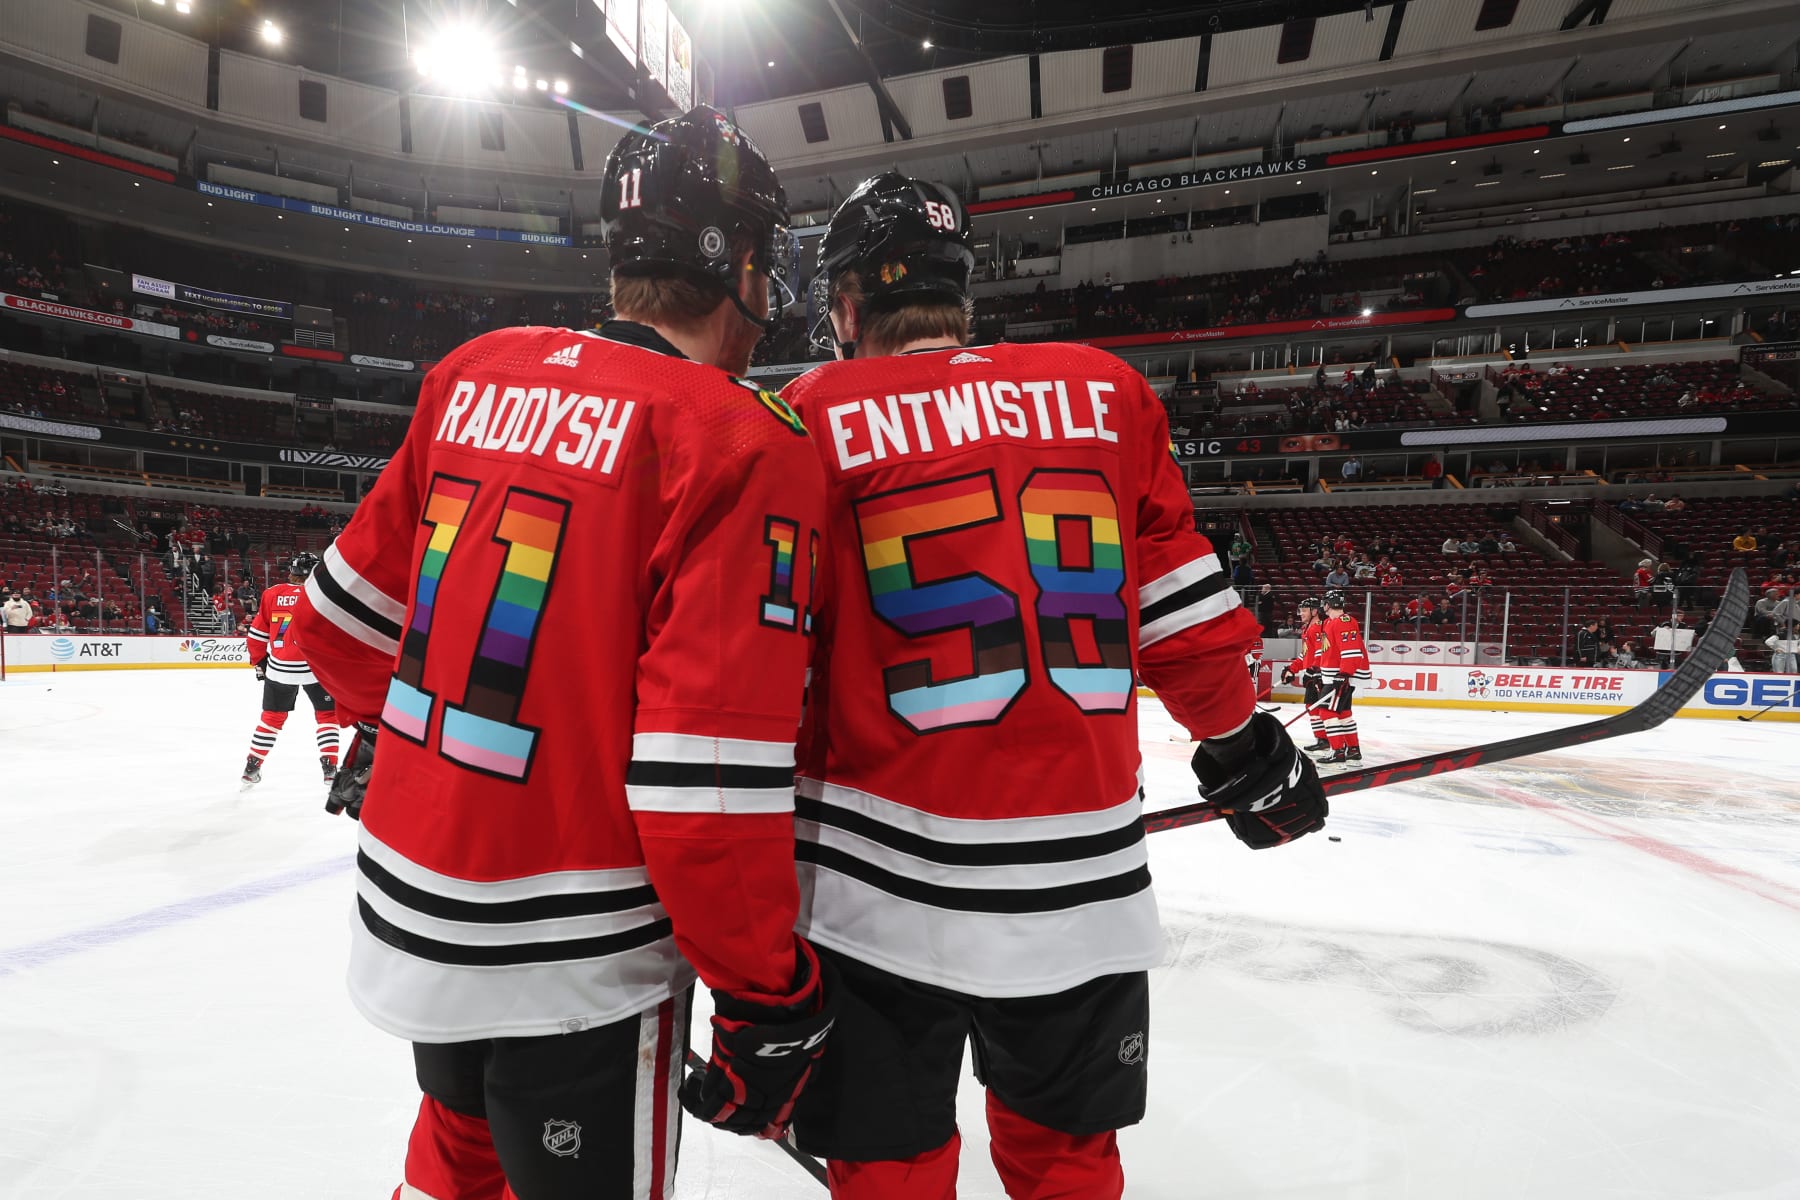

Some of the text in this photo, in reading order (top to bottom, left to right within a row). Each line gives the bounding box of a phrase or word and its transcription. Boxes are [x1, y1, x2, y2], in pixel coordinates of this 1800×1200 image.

[199, 183, 256, 201] BUD LIGHT
[619, 168, 642, 210] 11
[1092, 159, 1307, 198] CHICAGO BLACKHAWKS
[311, 205, 476, 237] BUD LIGHT LEGENDS LOUNGE
[925, 200, 955, 231] 58
[521, 233, 567, 245] BUD LIGHT
[16, 299, 123, 326] BLACKHAWKS.COM
[434, 380, 636, 475] RADDYSH
[827, 380, 1119, 471] ENTWISTLE
[1236, 438, 1261, 454] 43
[852, 467, 1133, 736] 58
[380, 471, 572, 784] 11
[79, 642, 122, 657] AT&T
[1494, 674, 1624, 690] BELLE TIRE
[1495, 689, 1623, 701] 100 YEAR ANNIVERSARY
[1125, 1038, 1139, 1058] NHL
[552, 1130, 573, 1146] NHL
